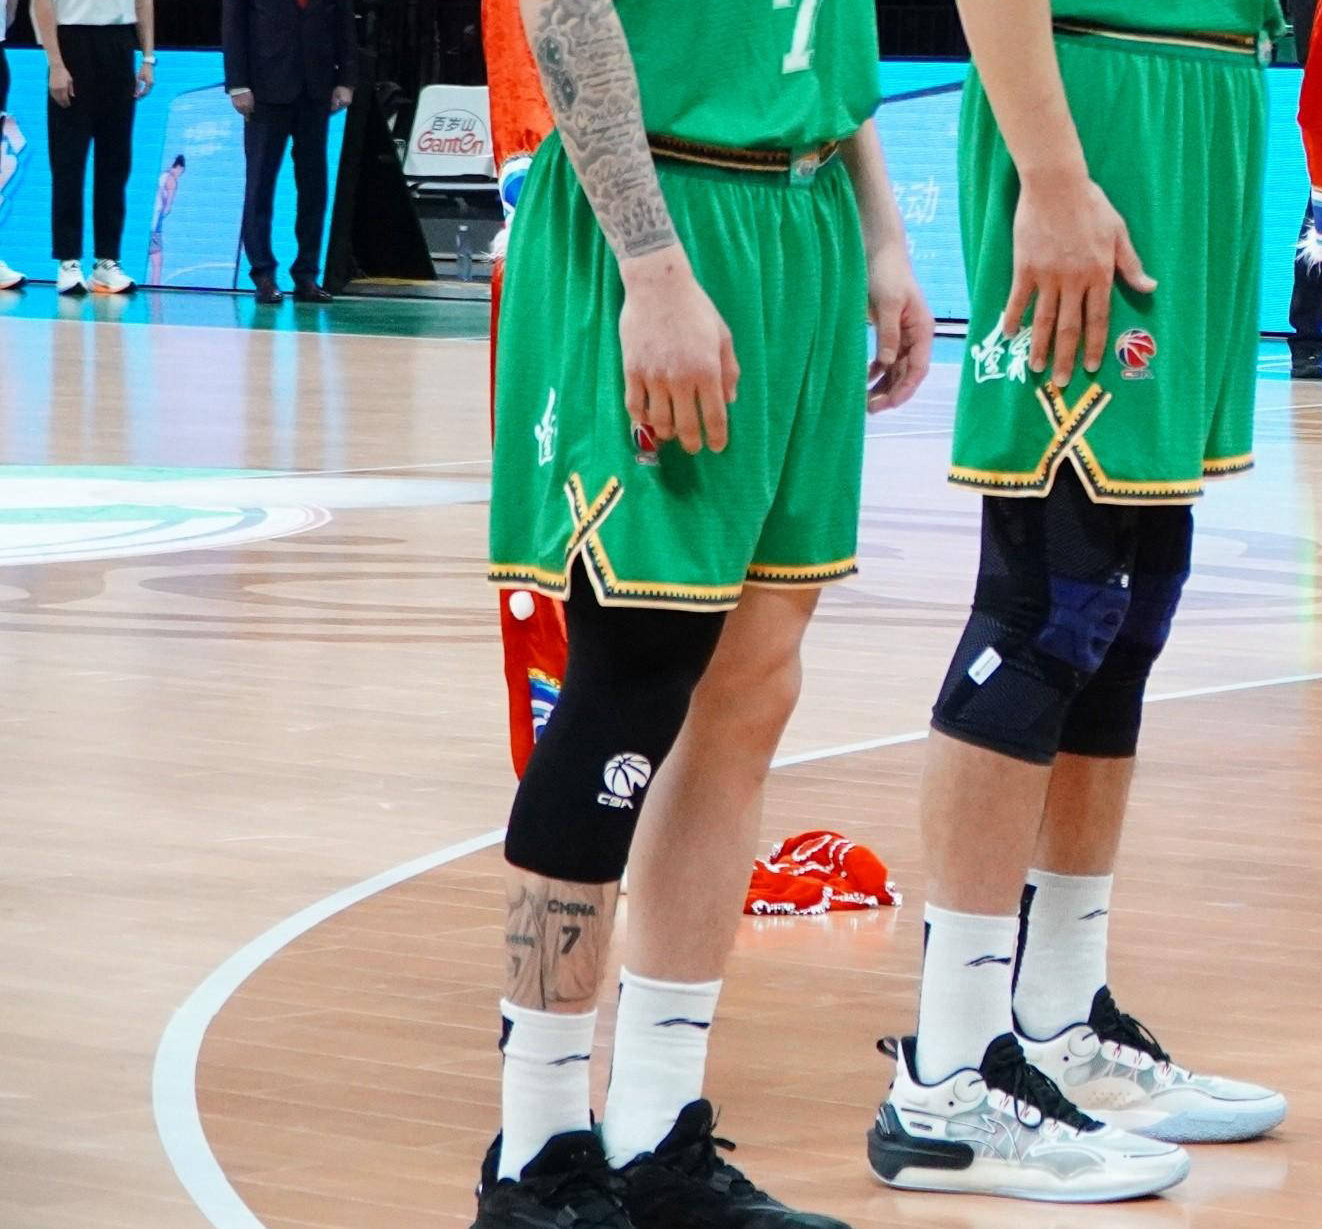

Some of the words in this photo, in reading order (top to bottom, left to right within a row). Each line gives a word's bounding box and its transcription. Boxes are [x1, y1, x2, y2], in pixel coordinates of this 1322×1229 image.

[430, 115, 477, 133] 百岁山
[596, 791, 635, 811] CBA
[546, 899, 598, 917] CHINA
[561, 925, 583, 956] 7
